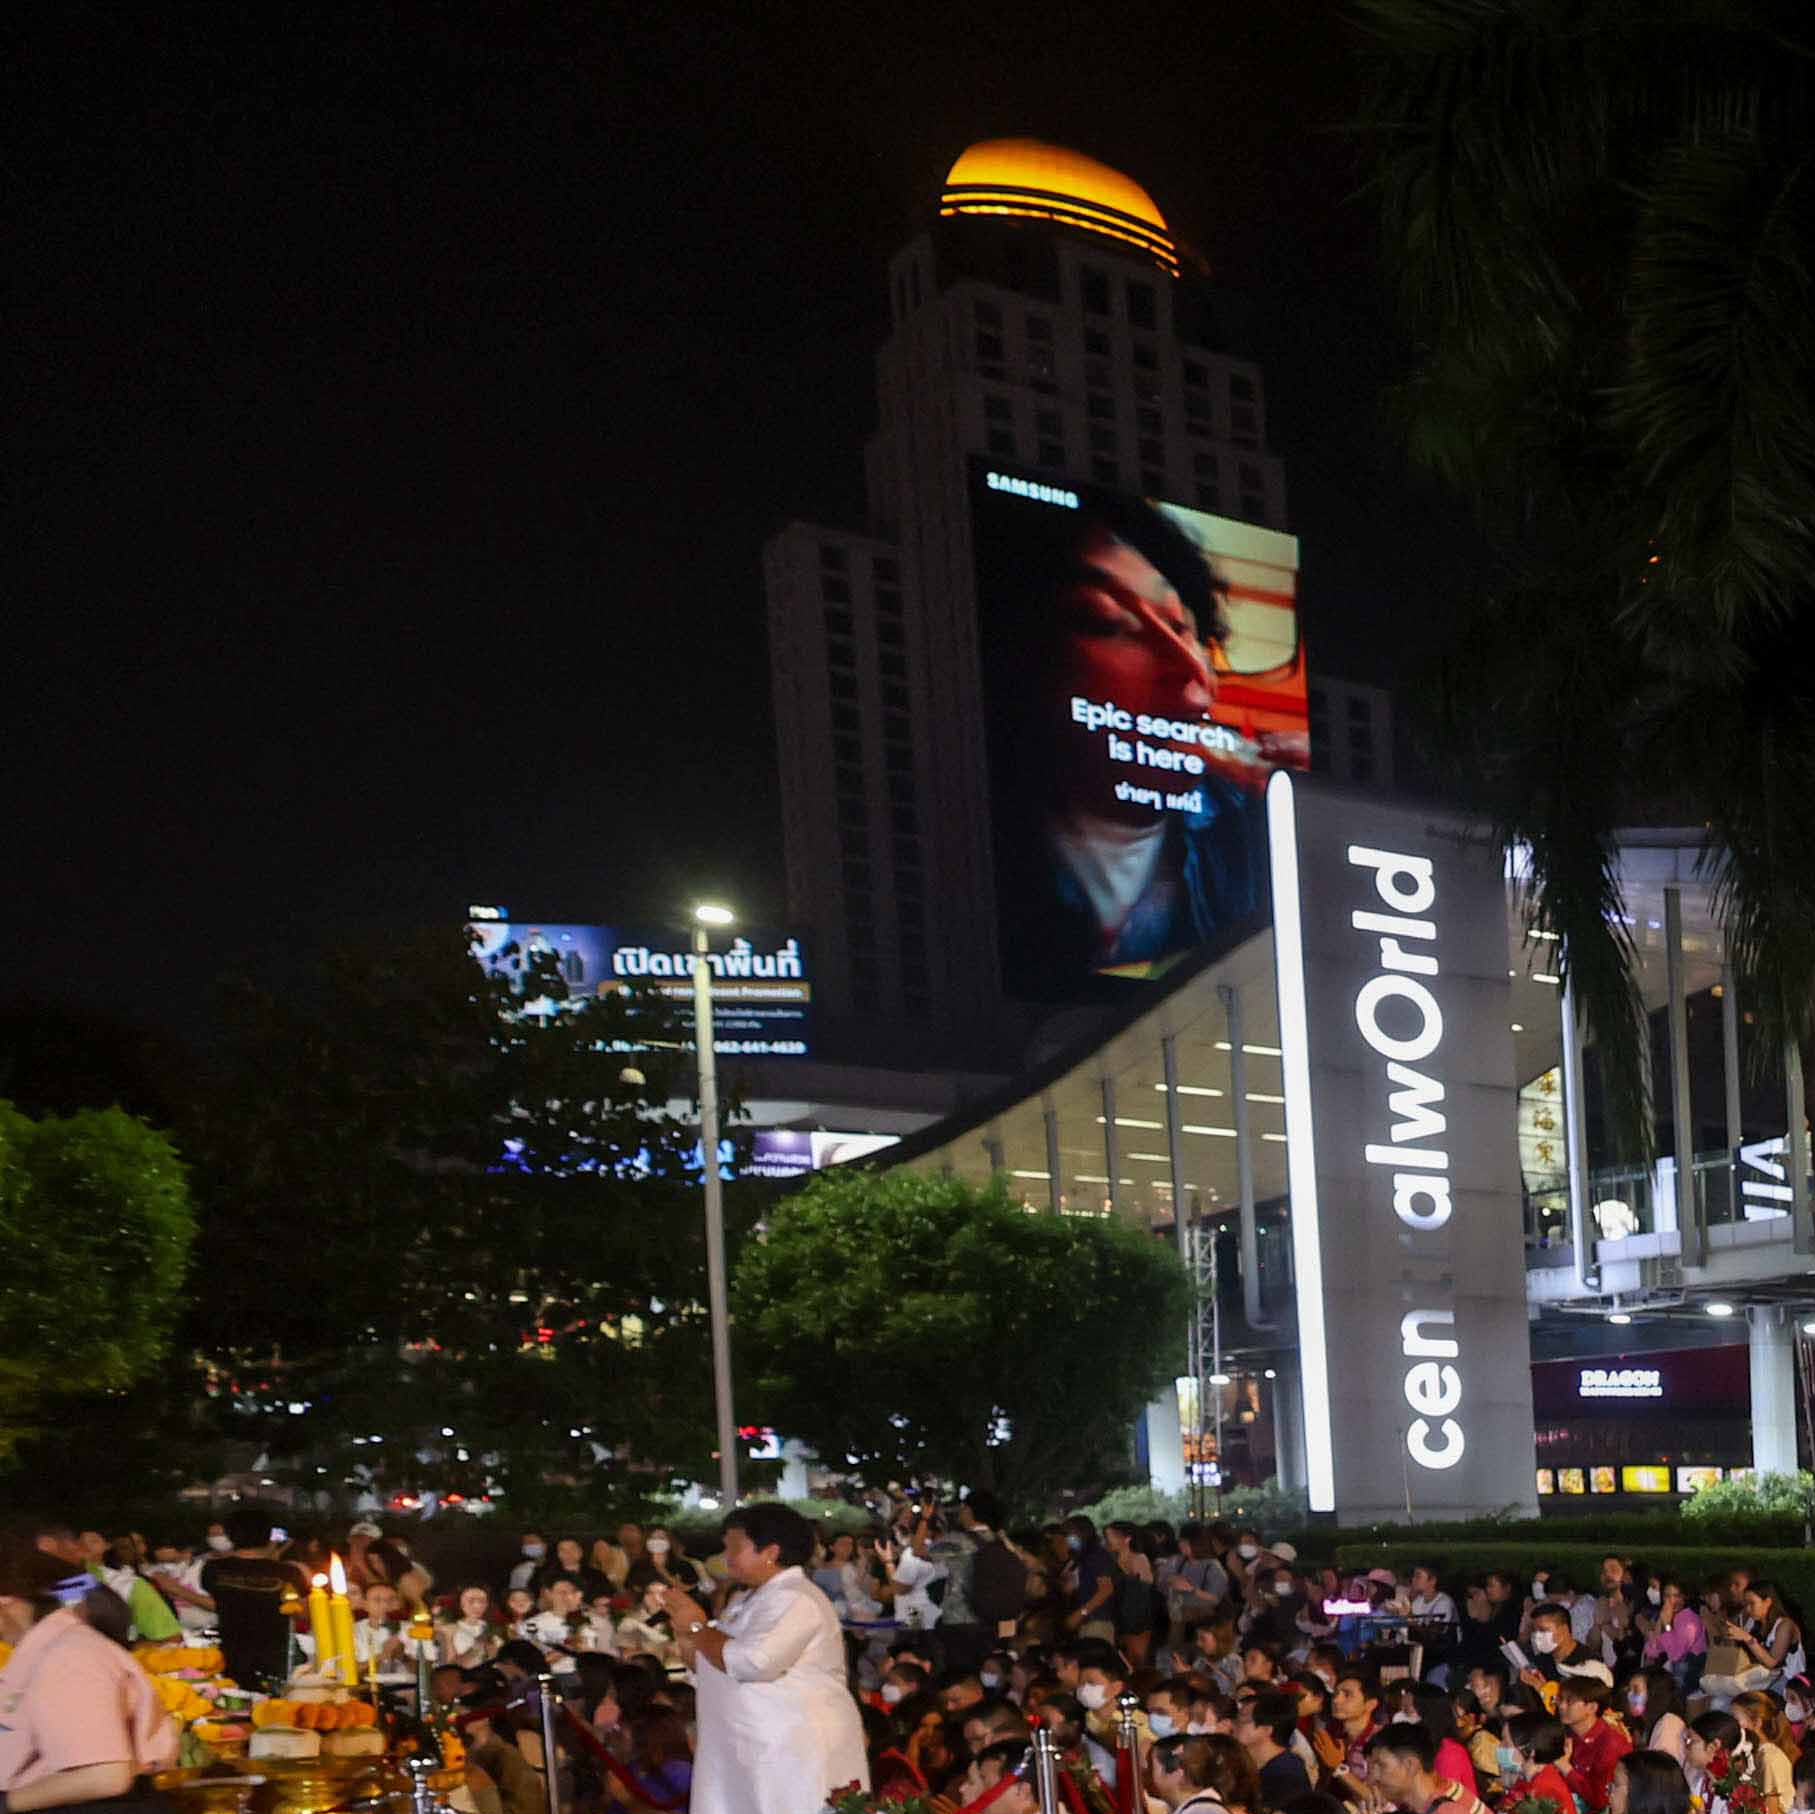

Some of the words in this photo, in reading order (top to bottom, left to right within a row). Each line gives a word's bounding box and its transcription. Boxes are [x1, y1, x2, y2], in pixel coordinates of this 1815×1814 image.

[986, 465, 1080, 510] SAMSUNG
[1070, 696, 1133, 731] Epic
[1135, 713, 1236, 753] search
[1107, 733, 1133, 763] is
[1137, 738, 1206, 775] here
[1580, 1369, 1660, 1387] DRAGON
